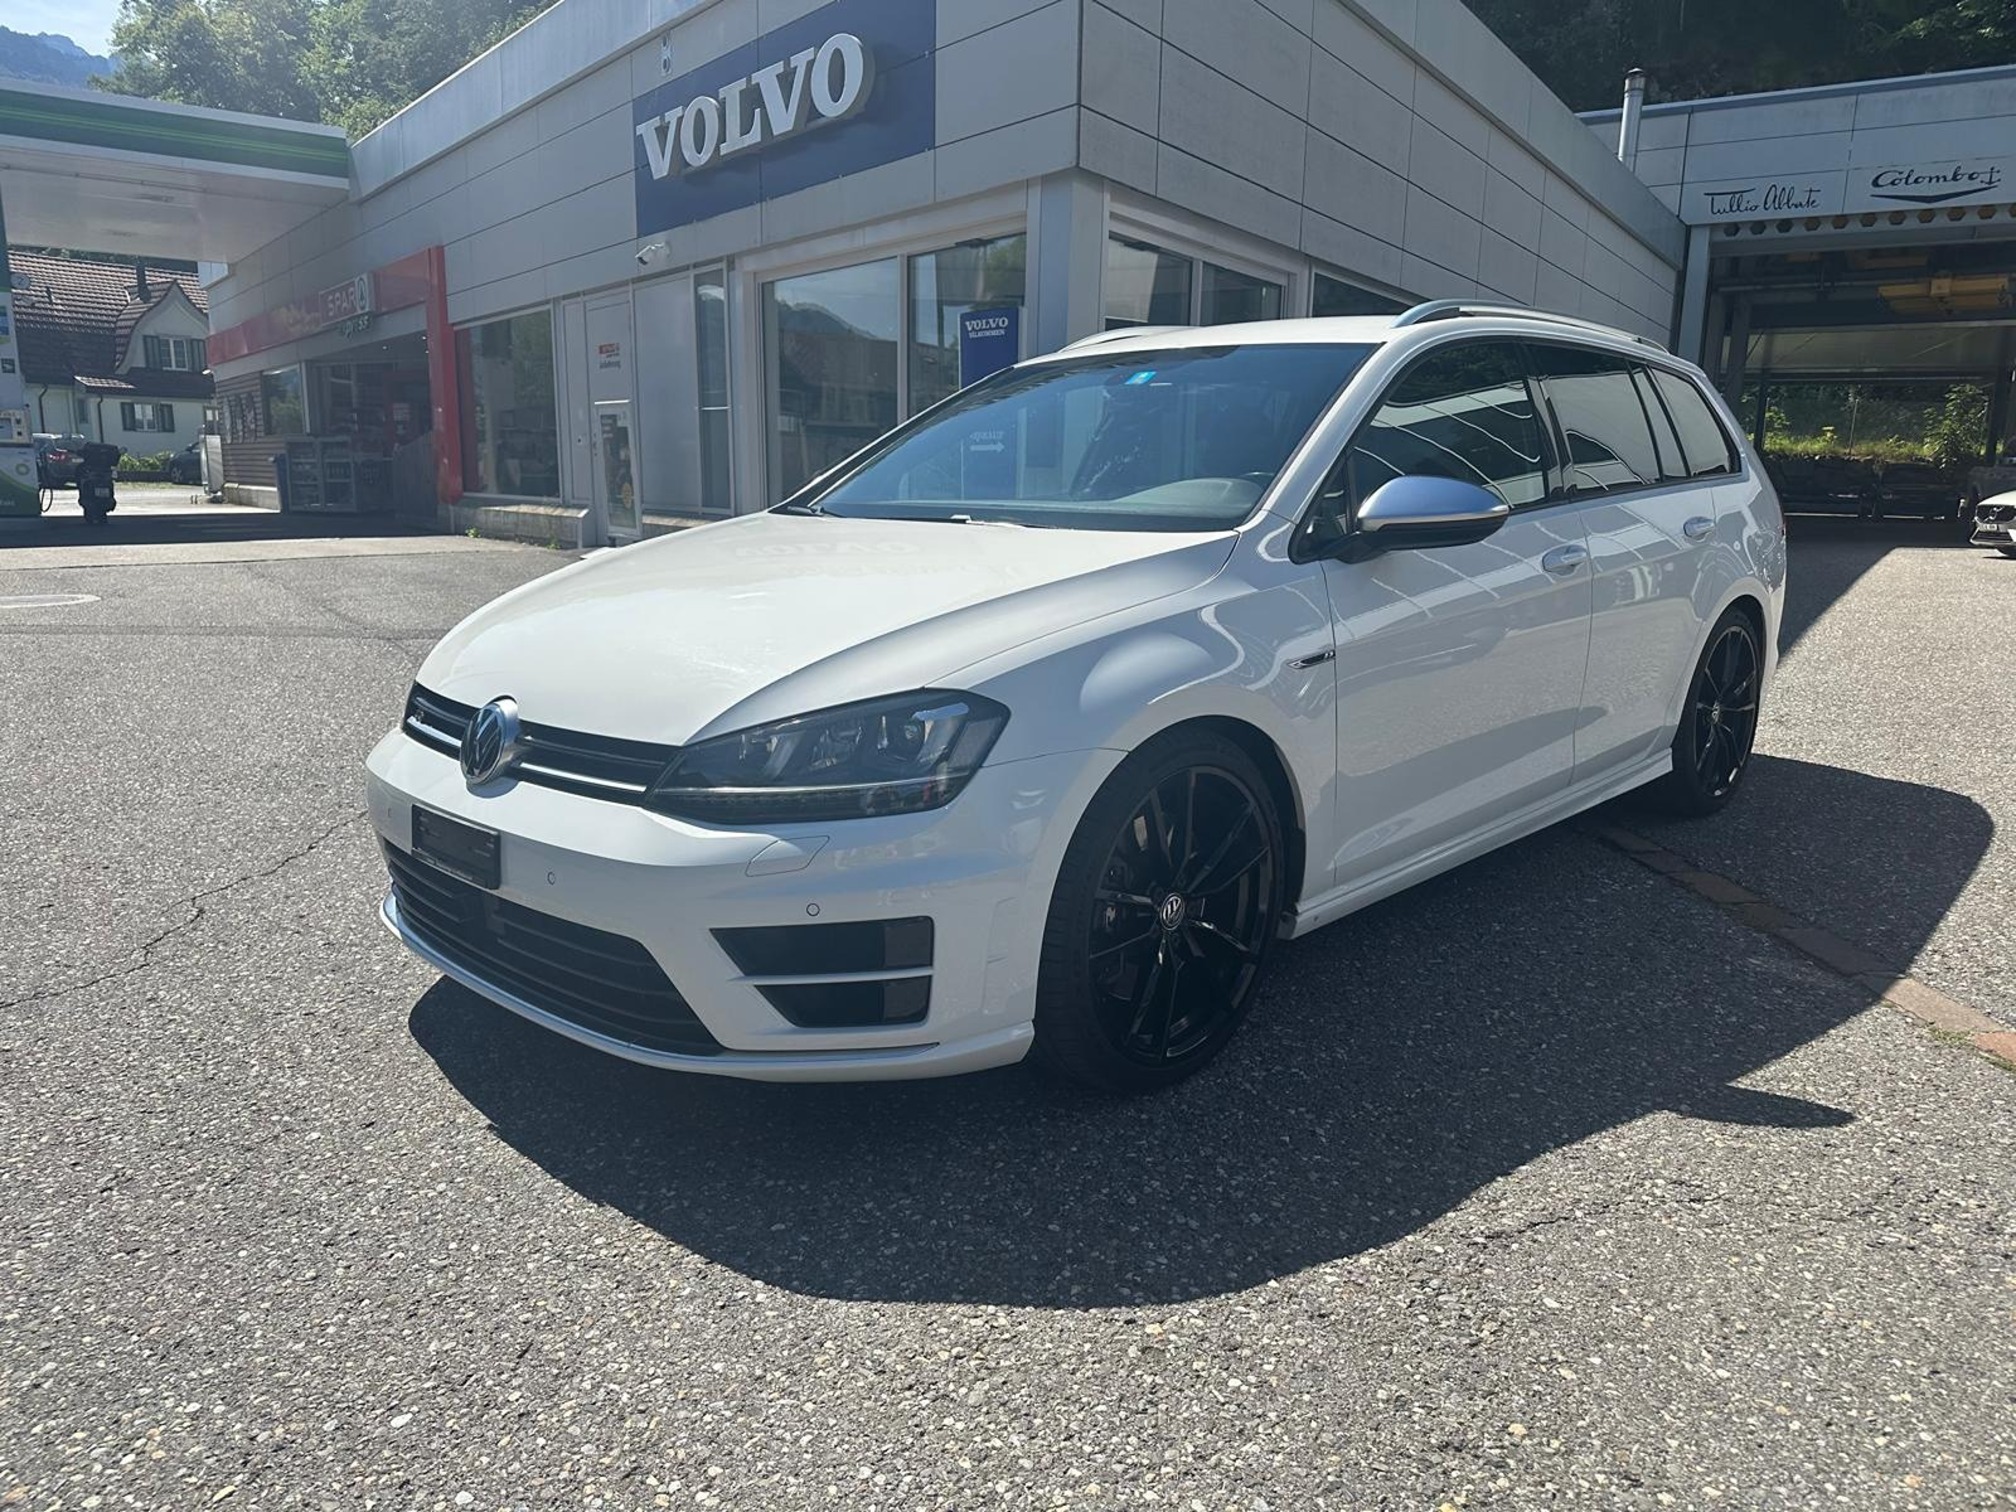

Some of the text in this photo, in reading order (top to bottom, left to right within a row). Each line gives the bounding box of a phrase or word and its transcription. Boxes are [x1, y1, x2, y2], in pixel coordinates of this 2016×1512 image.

[635, 33, 866, 180] VOLVO
[1871, 166, 1981, 188] Colombo
[1703, 184, 1822, 215] Tullio Abbate
[327, 286, 357, 317] SPAR
[965, 317, 1009, 331] VOLVO
